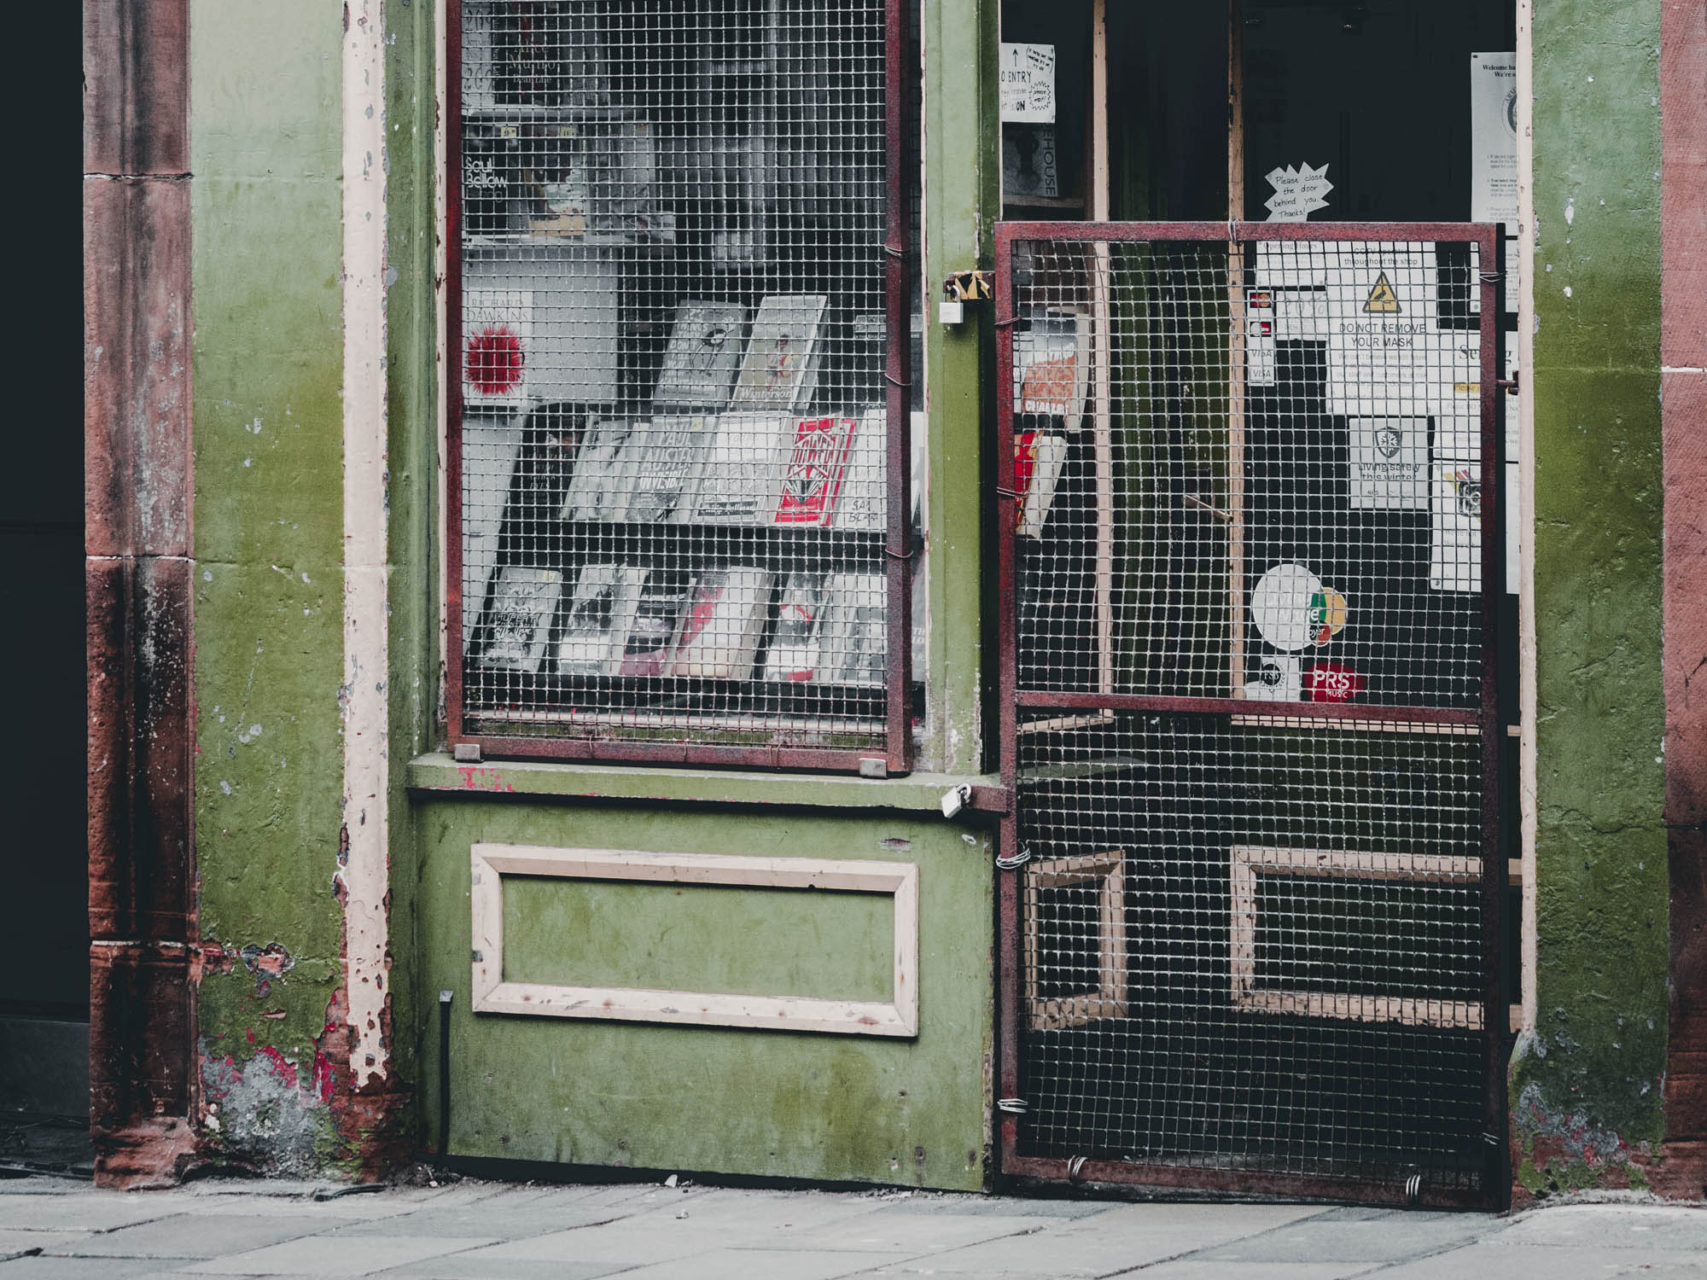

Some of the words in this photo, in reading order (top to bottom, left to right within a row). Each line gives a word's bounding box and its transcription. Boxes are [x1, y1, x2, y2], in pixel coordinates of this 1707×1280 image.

[1008, 71, 1032, 83] ENTRY
[465, 156, 494, 174] Saul
[465, 170, 508, 188] Bellow
[1275, 175, 1299, 185] Please
[1304, 174, 1323, 182] close
[1301, 185, 1318, 193] door
[1274, 197, 1297, 208] behind
[1279, 207, 1306, 219] Thanks!
[466, 310, 529, 321] DAWKINS
[1339, 323, 1355, 334] DO
[1357, 323, 1378, 334] NOT
[1381, 323, 1427, 334] REMOVE
[1351, 337, 1380, 347] YOUR
[1384, 337, 1414, 347] MASK
[1252, 369, 1271, 378] VISA
[739, 387, 793, 399] Winterson
[1358, 462, 1388, 473] Living
[1389, 462, 1421, 473] safely
[1314, 670, 1350, 689] PRS
[1326, 690, 1348, 699] MUSIC
